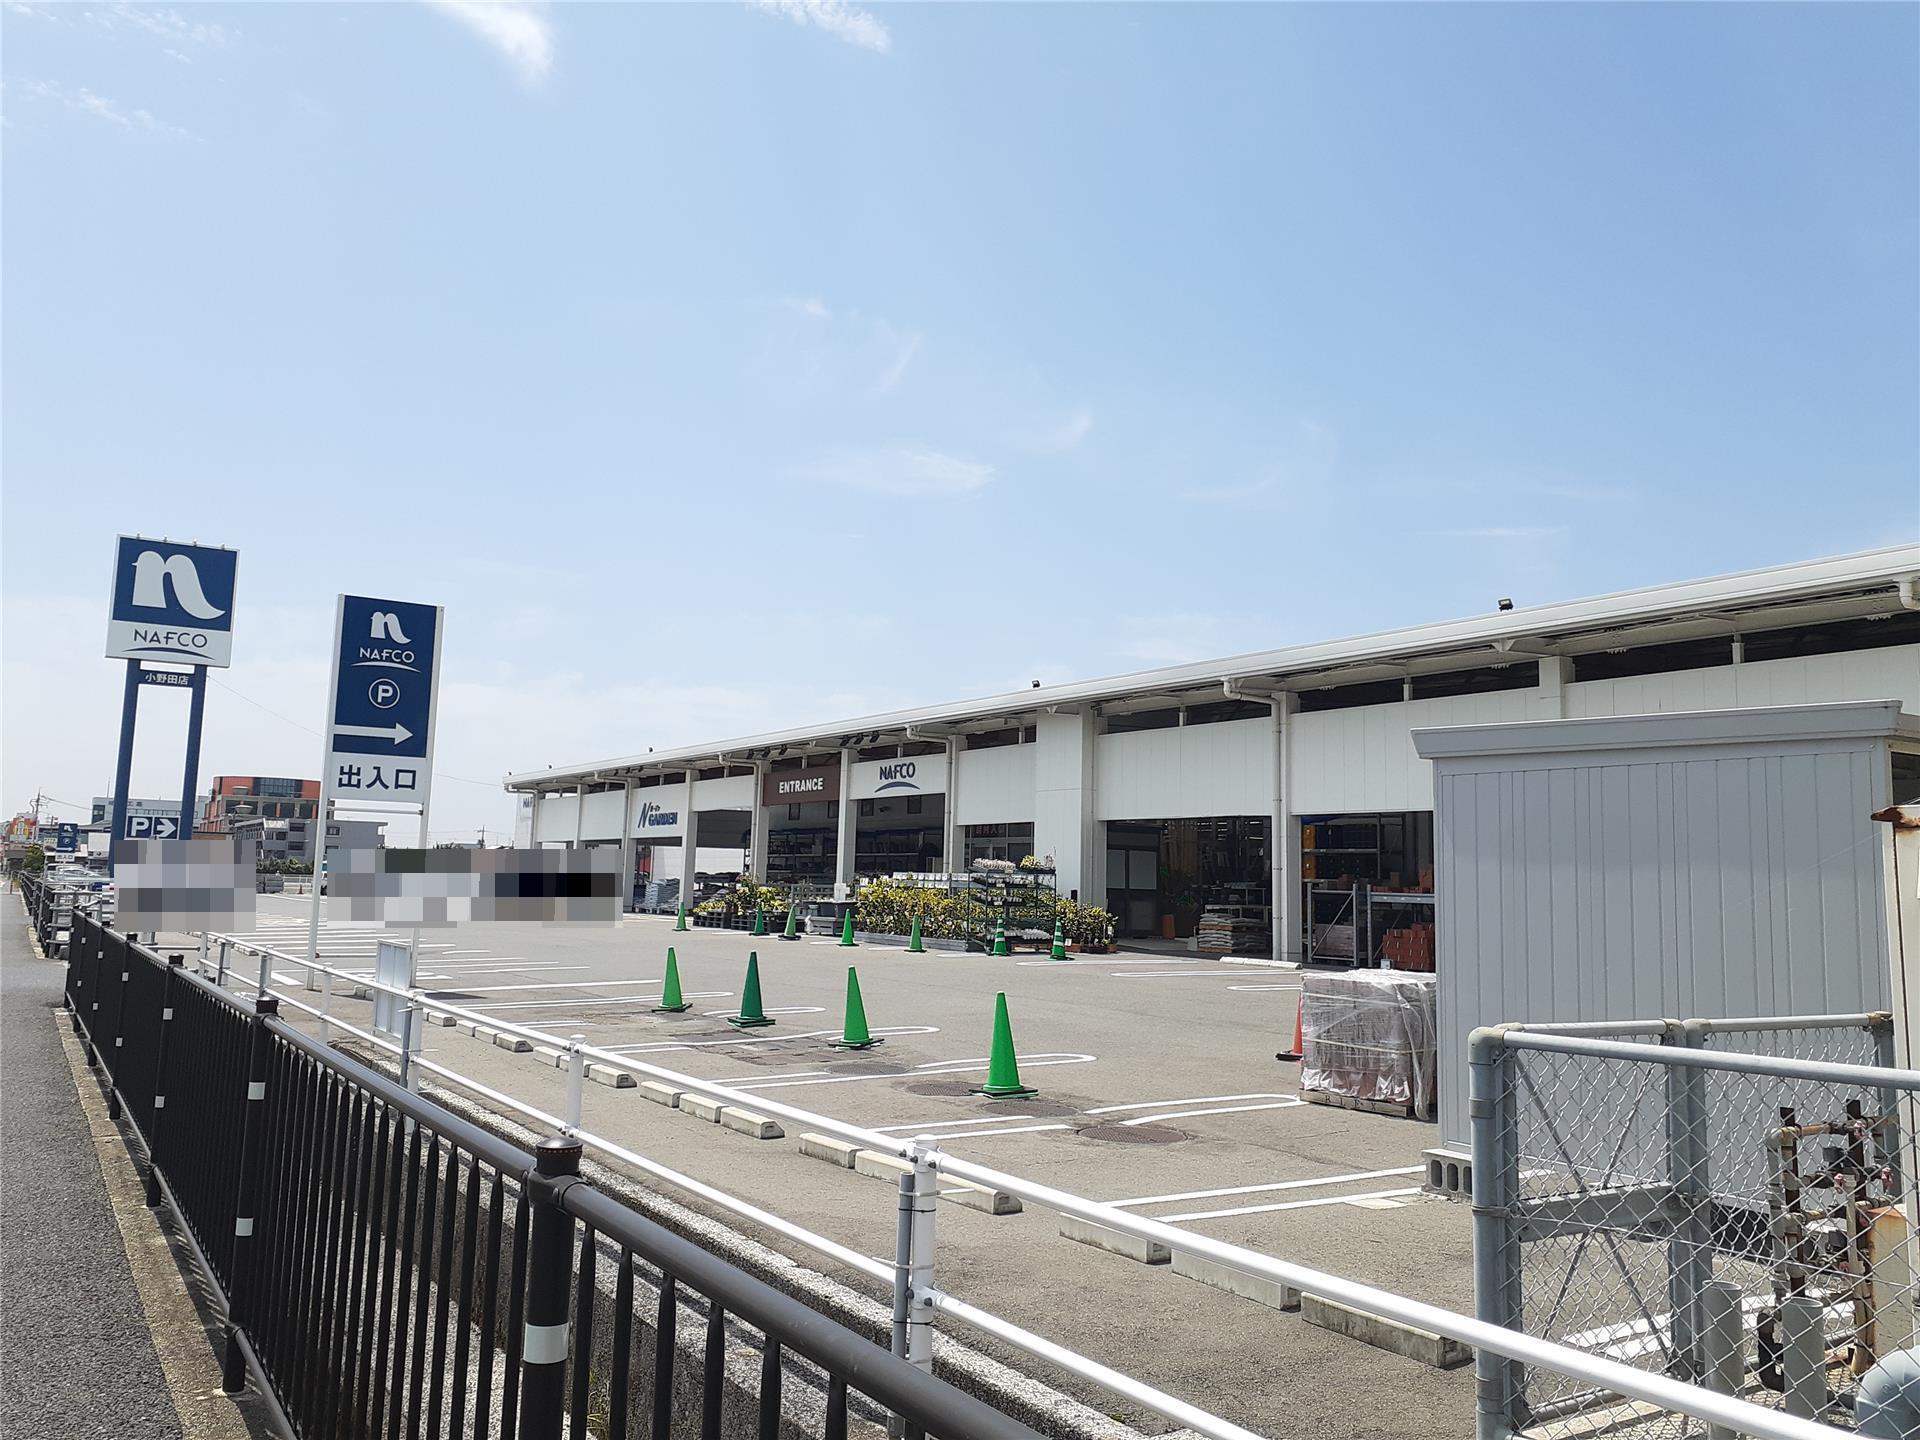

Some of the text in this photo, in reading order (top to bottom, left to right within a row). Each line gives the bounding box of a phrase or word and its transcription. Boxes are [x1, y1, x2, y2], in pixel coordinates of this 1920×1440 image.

[133, 628, 208, 649] NAFCO
[359, 646, 415, 663] NAFCO
[144, 672, 190, 686] 小野田店
[376, 684, 394, 703] P
[337, 764, 417, 790] 出入口
[879, 761, 916, 781] NAFCO
[778, 777, 824, 794] ENTRANCE
[130, 817, 150, 837] P
